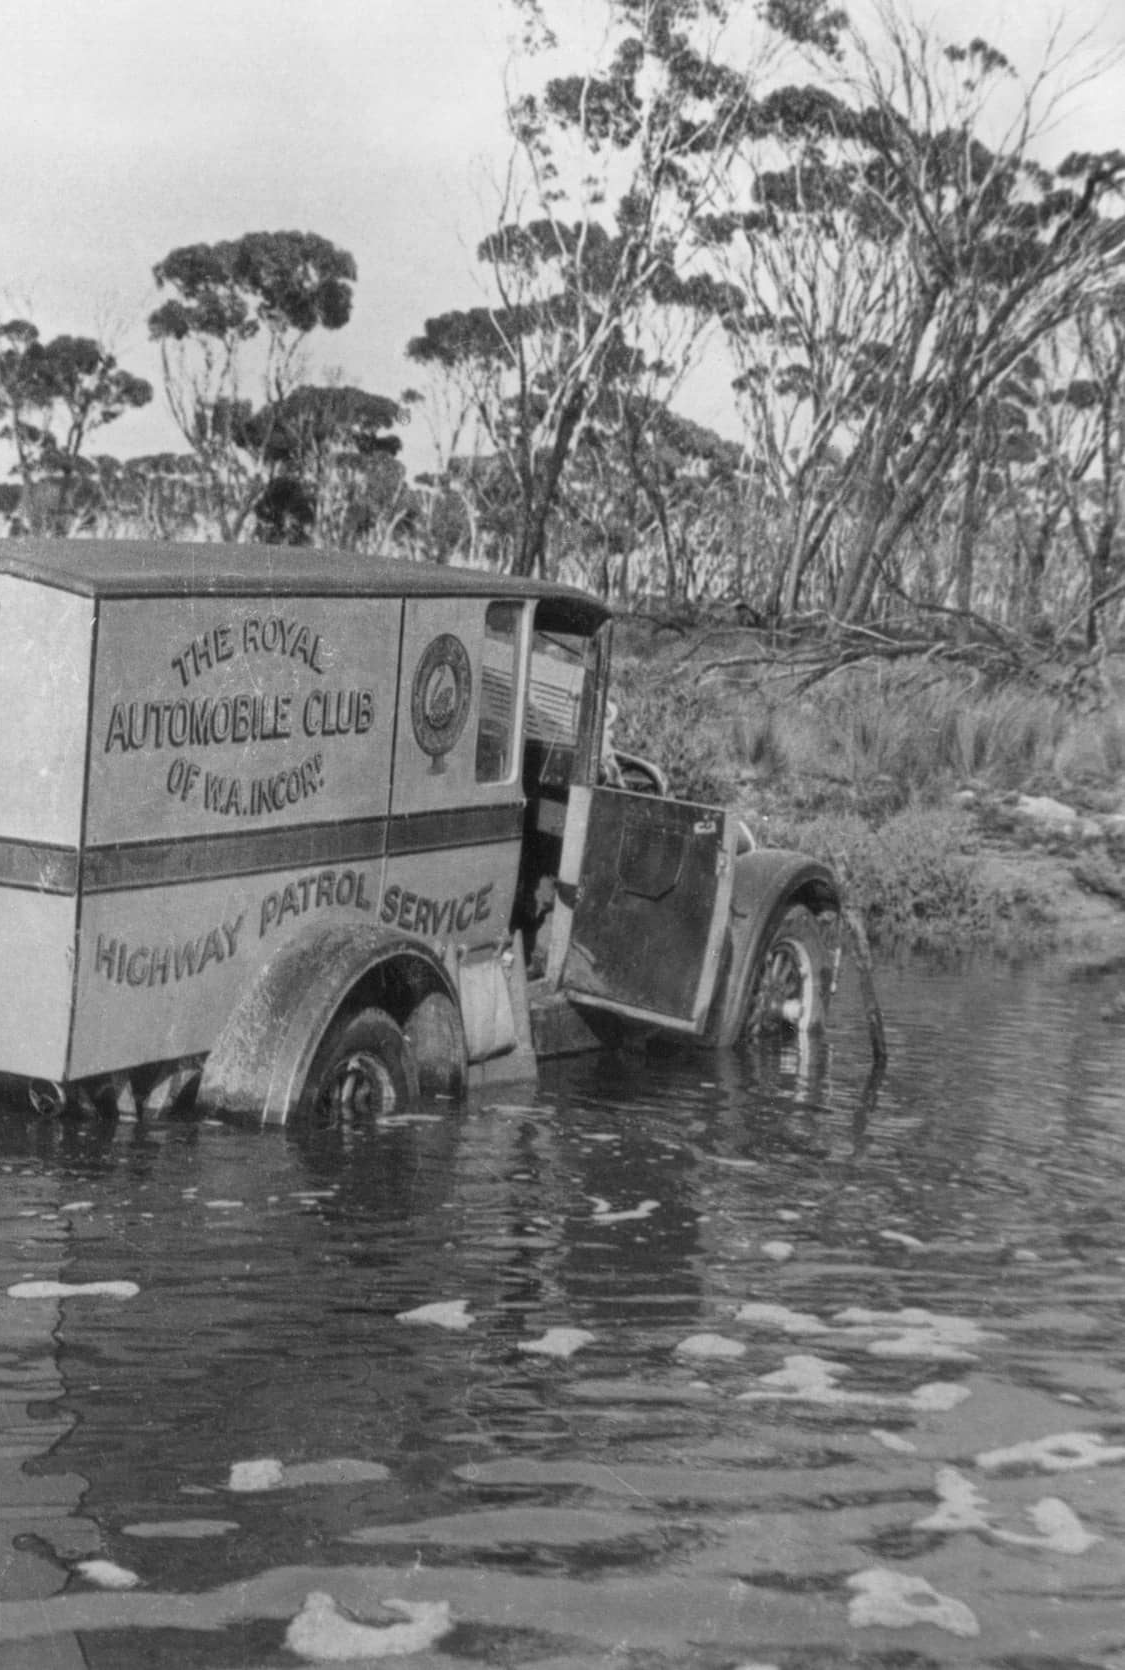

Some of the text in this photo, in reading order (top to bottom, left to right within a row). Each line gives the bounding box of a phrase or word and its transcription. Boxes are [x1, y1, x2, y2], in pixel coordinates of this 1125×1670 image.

[171, 615, 325, 687] THE ROYAL
[104, 694, 293, 754] AUTOMOBILE
[302, 689, 374, 738] CLUB
[167, 757, 202, 802] OF
[94, 869, 494, 988] HIGHWAY PATROL SERVICE
